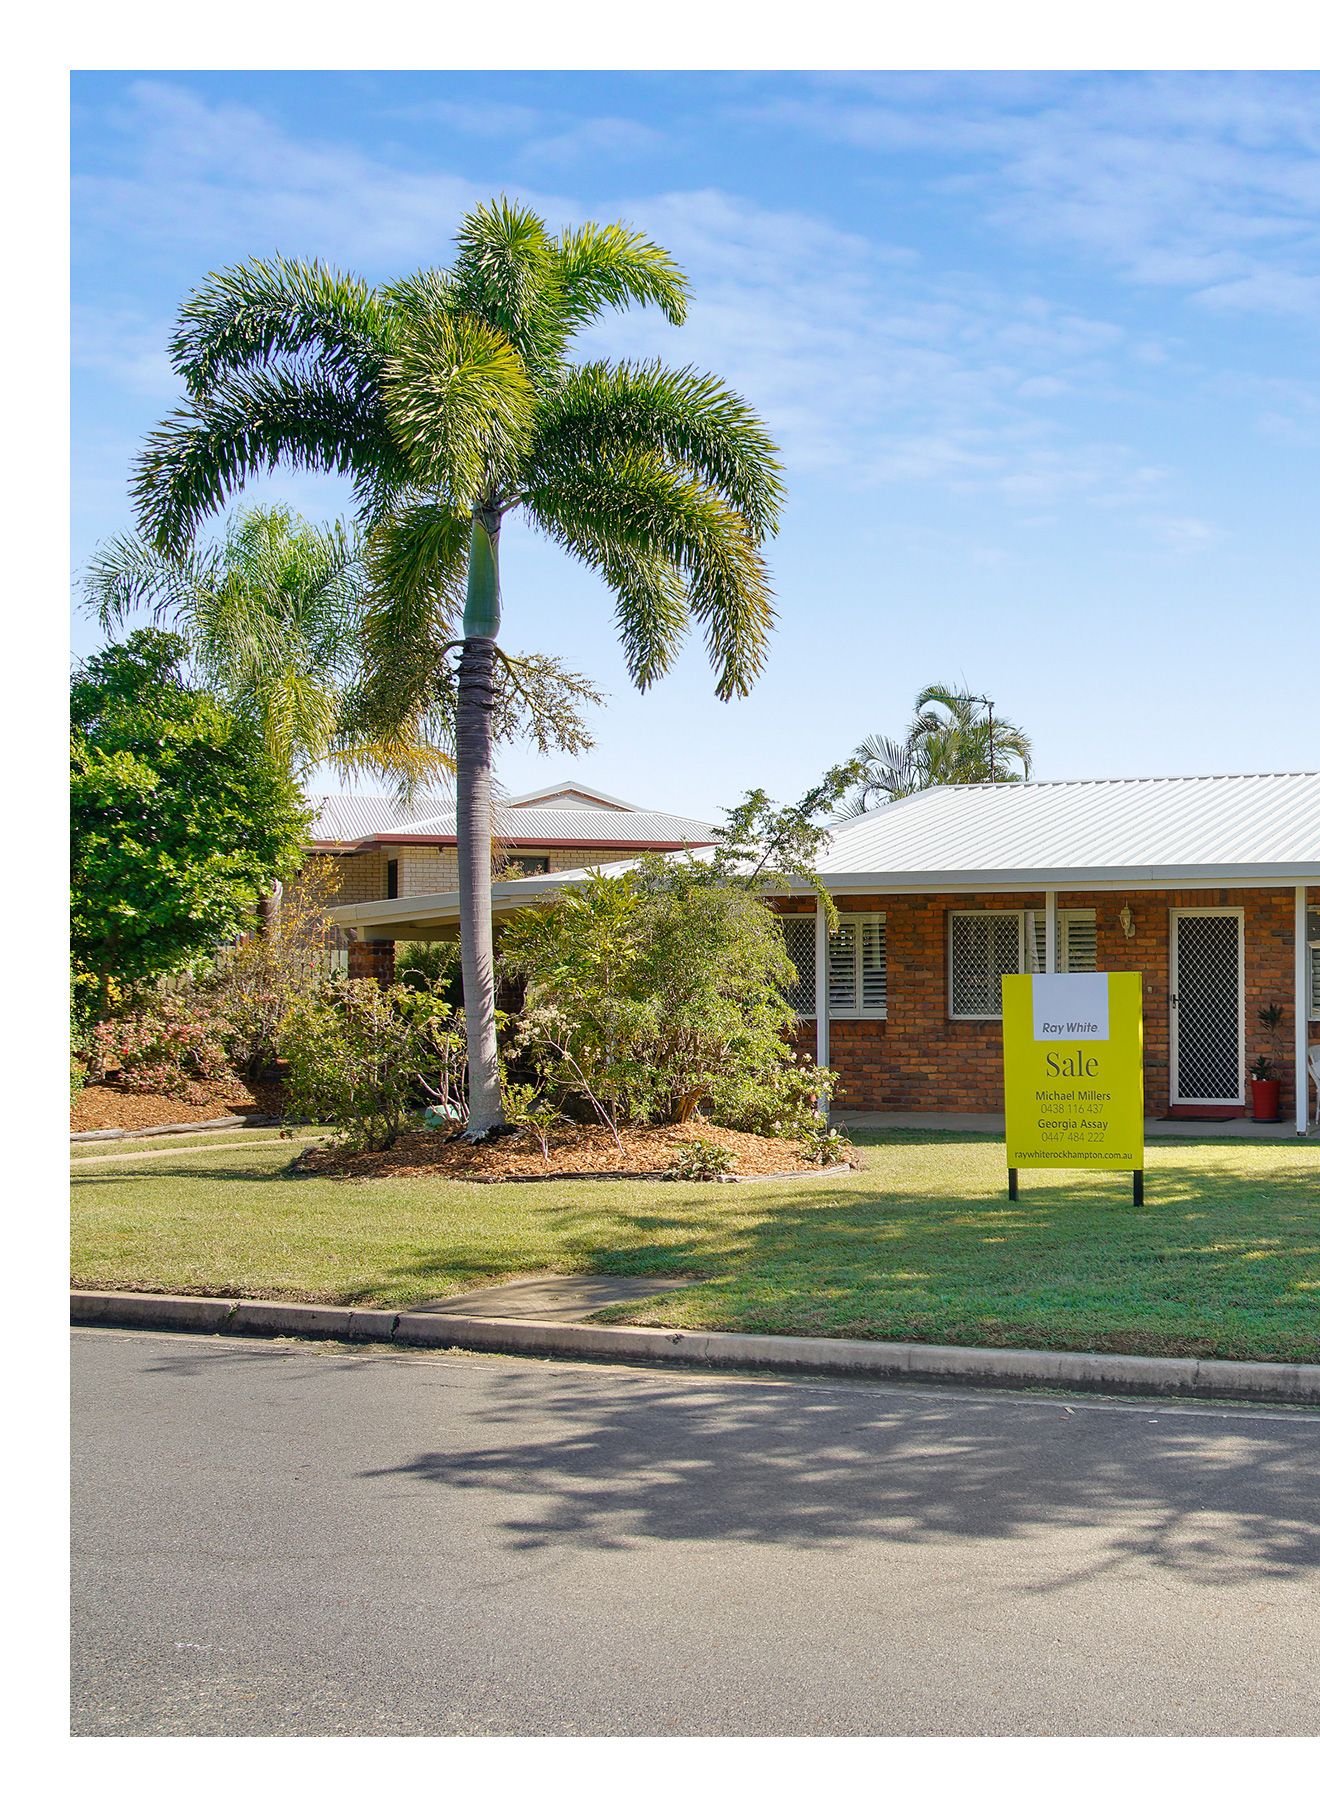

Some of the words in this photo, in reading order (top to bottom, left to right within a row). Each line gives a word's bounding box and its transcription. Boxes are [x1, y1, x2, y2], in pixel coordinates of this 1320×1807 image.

[1042, 1022, 1064, 1034] Ray
[1066, 1022, 1098, 1033] White
[1046, 1050, 1100, 1078] Sale
[1035, 1091, 1075, 1101] Michael
[1078, 1091, 1111, 1101] Millers
[1041, 1104, 1065, 1114] 0438
[1068, 1104, 1085, 1114] 116
[1087, 1104, 1104, 1114] 437
[1038, 1119, 1077, 1131] Georgia
[1080, 1119, 1109, 1130] Assay
[1041, 1132, 1065, 1142] 0447
[1068, 1132, 1085, 1142] 484
[1087, 1132, 1105, 1142] 222
[1015, 1150, 1133, 1160] raywhiterockhampton.com.au
